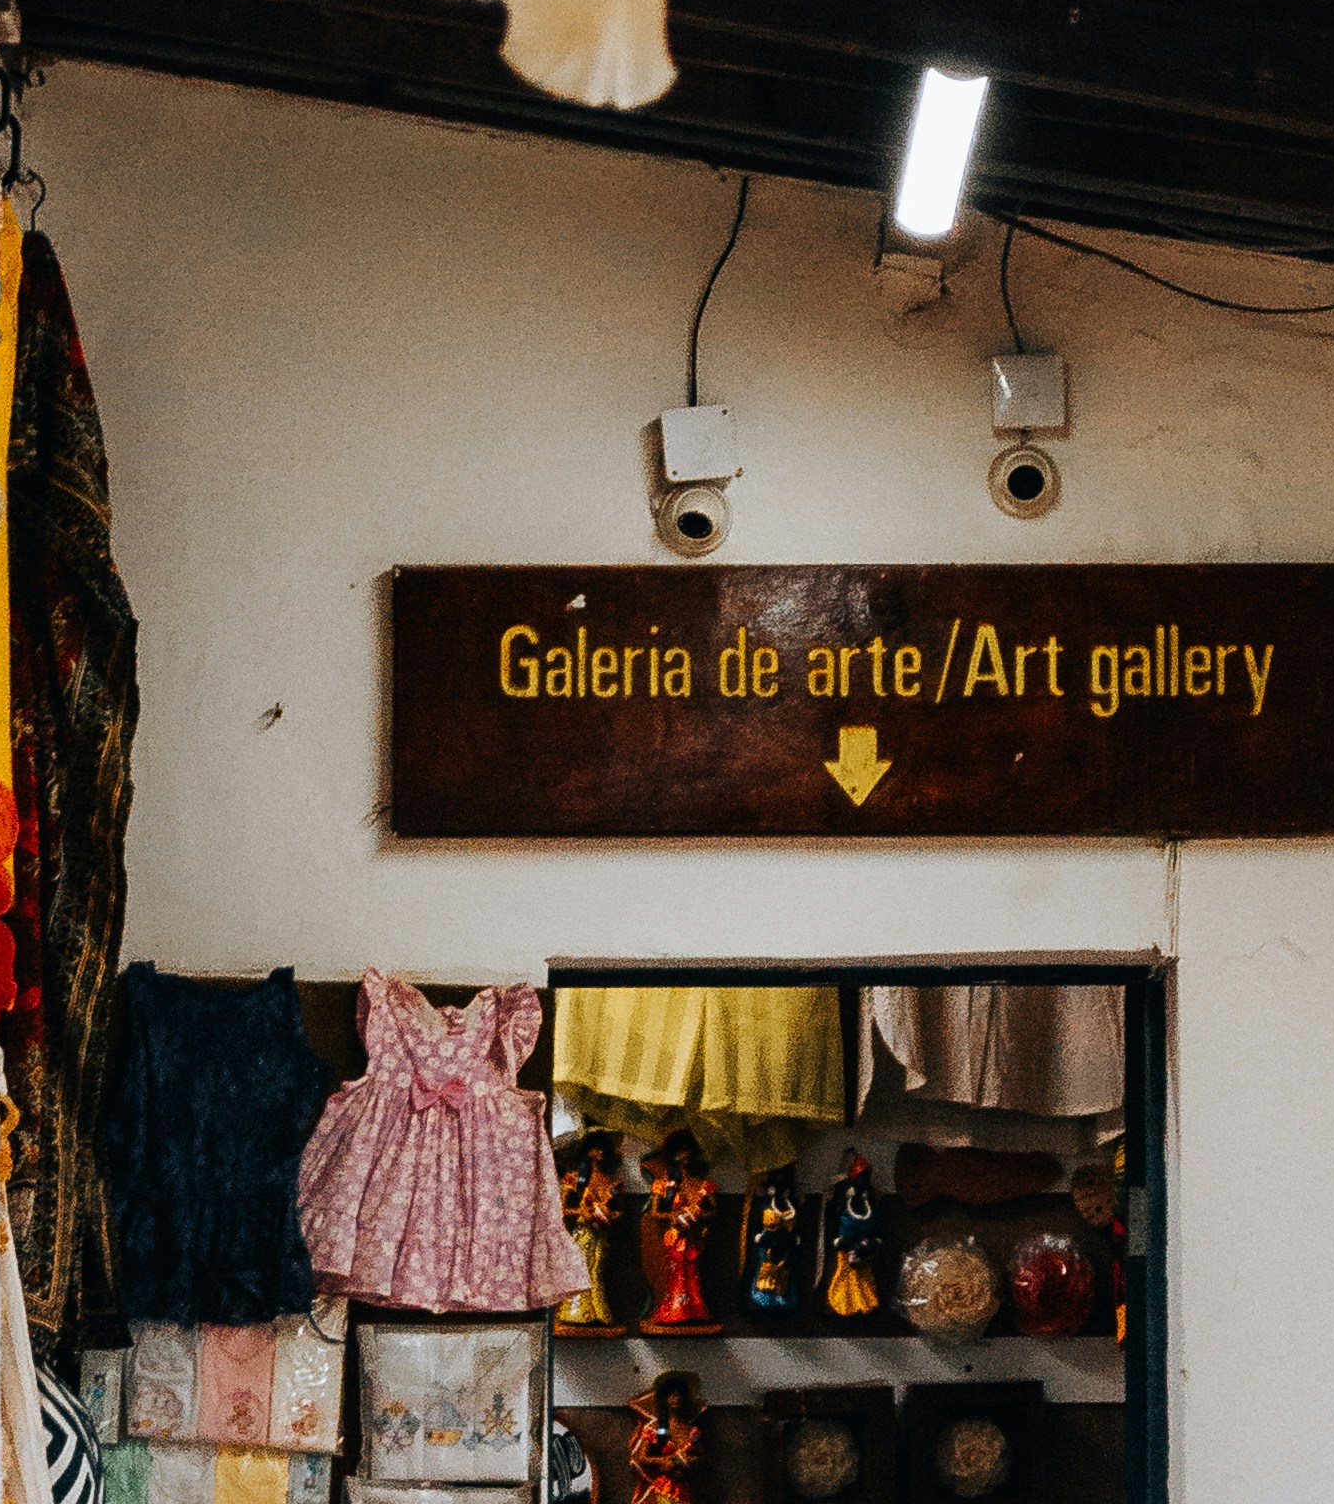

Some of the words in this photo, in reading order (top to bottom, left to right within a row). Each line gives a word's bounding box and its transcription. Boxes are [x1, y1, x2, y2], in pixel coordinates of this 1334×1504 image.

[499, 625, 691, 698] Galeria
[719, 626, 779, 698] de
[1091, 625, 1274, 718] gallery
